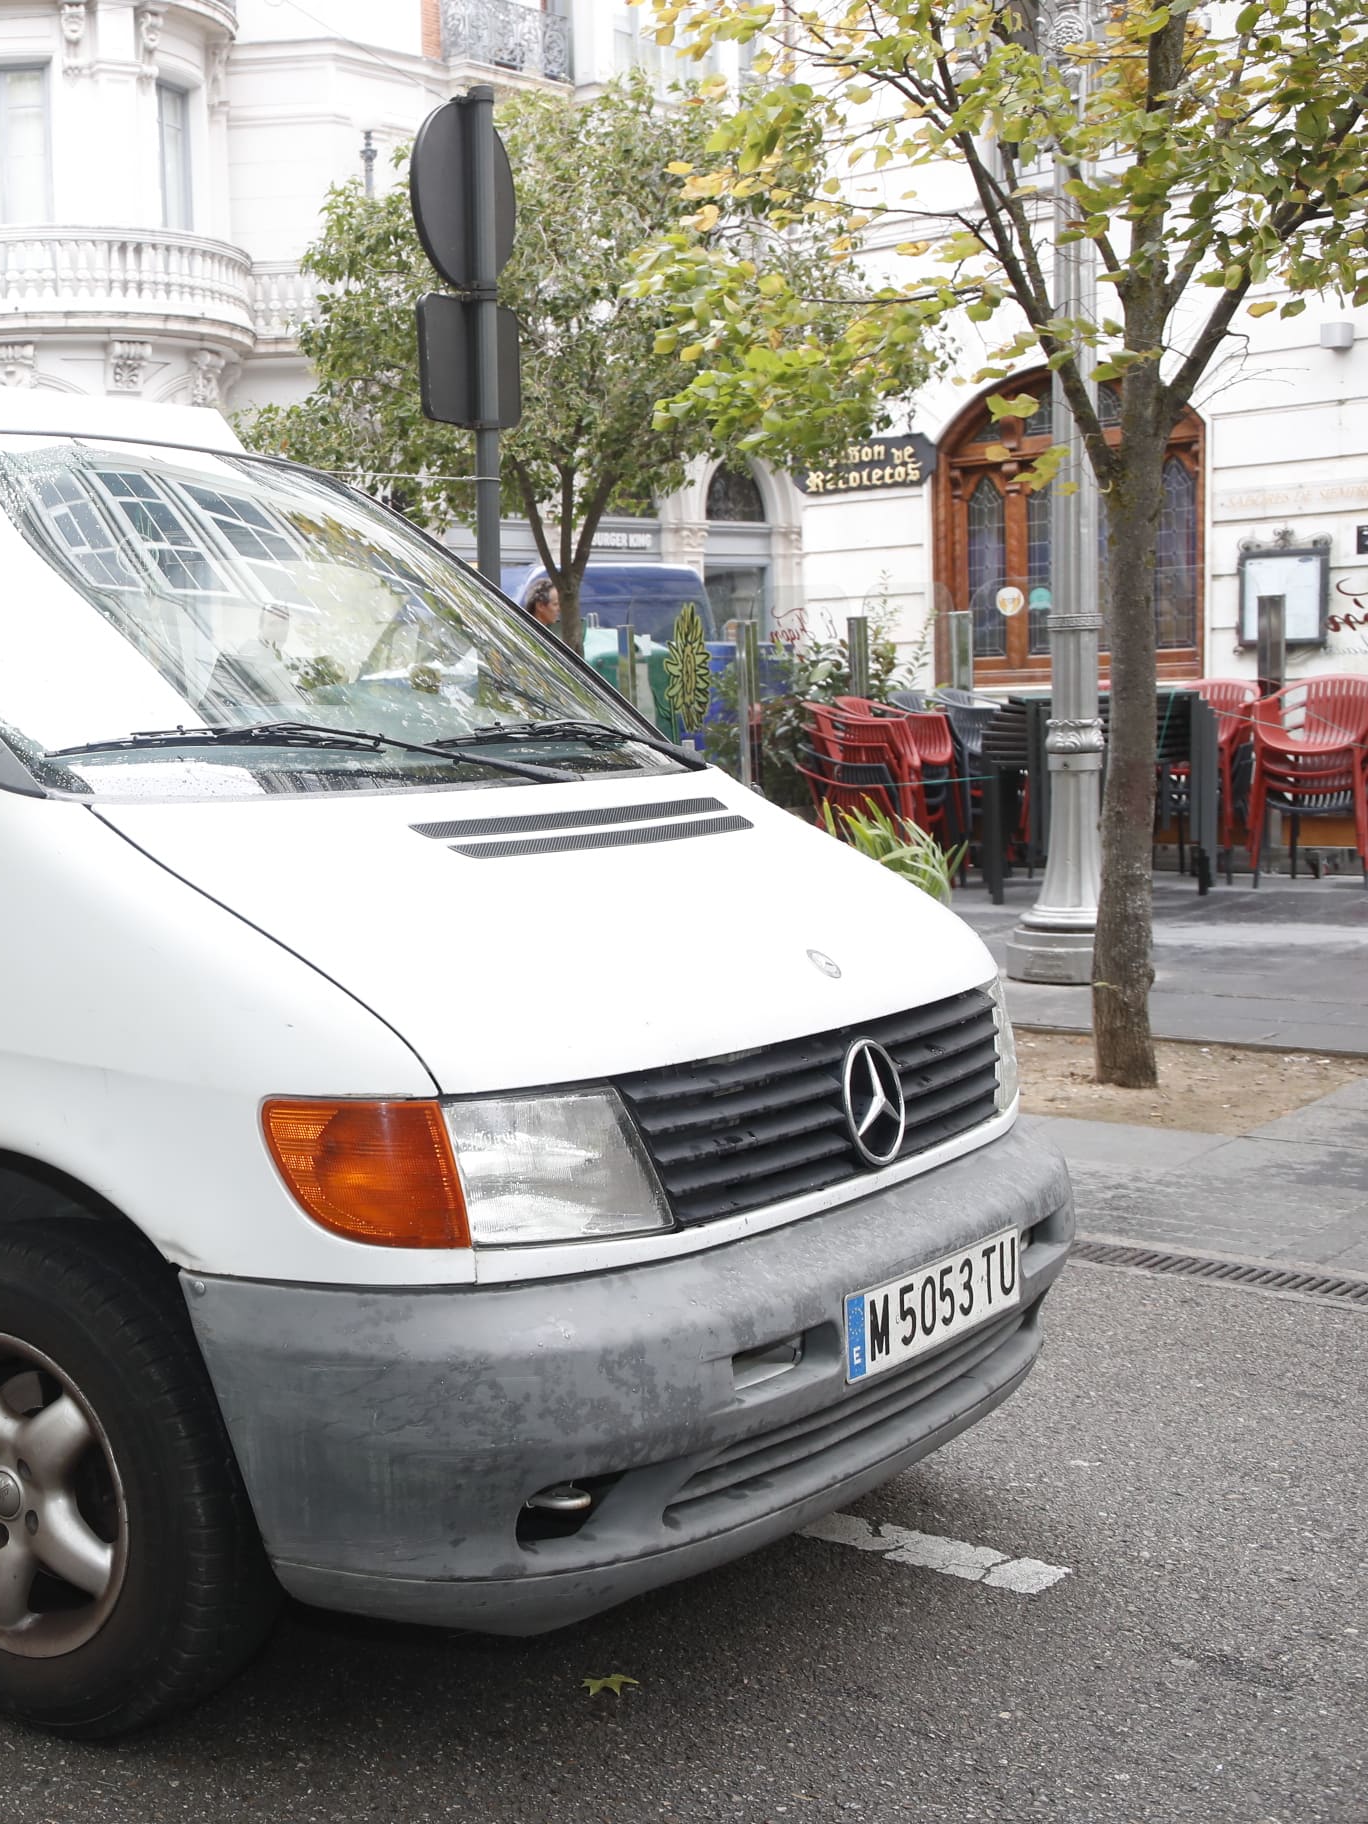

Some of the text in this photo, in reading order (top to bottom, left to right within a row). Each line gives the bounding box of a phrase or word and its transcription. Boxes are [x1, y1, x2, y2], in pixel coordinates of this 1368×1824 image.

[806, 461, 923, 492] Recoletos
[628, 533, 652, 548] KING
[869, 1237, 1016, 1362] M 5053 TU
